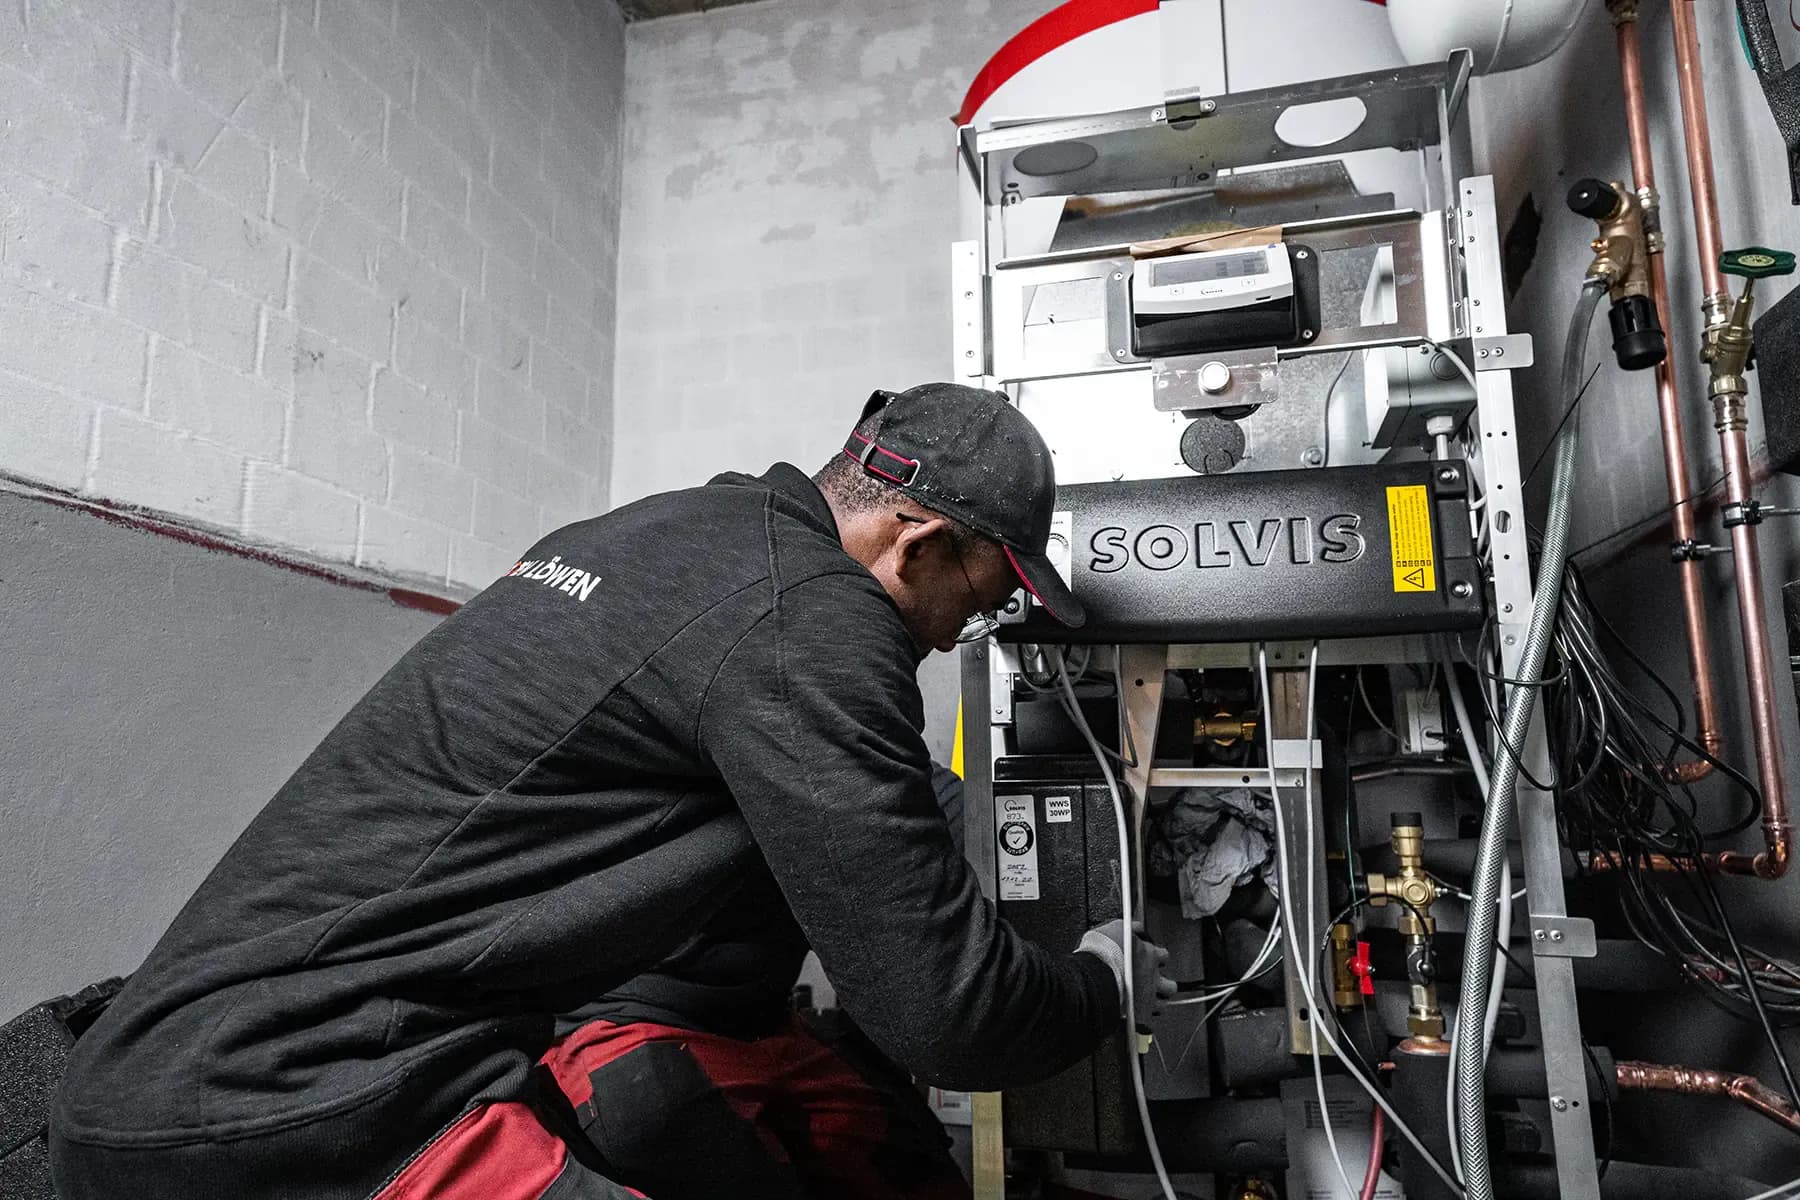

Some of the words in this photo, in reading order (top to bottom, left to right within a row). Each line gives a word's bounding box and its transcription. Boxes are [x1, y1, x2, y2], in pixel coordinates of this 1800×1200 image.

[1090, 513, 1365, 573] SOLVIS
[1048, 800, 1069, 808] WWS
[1049, 809, 1071, 817] 30WP
